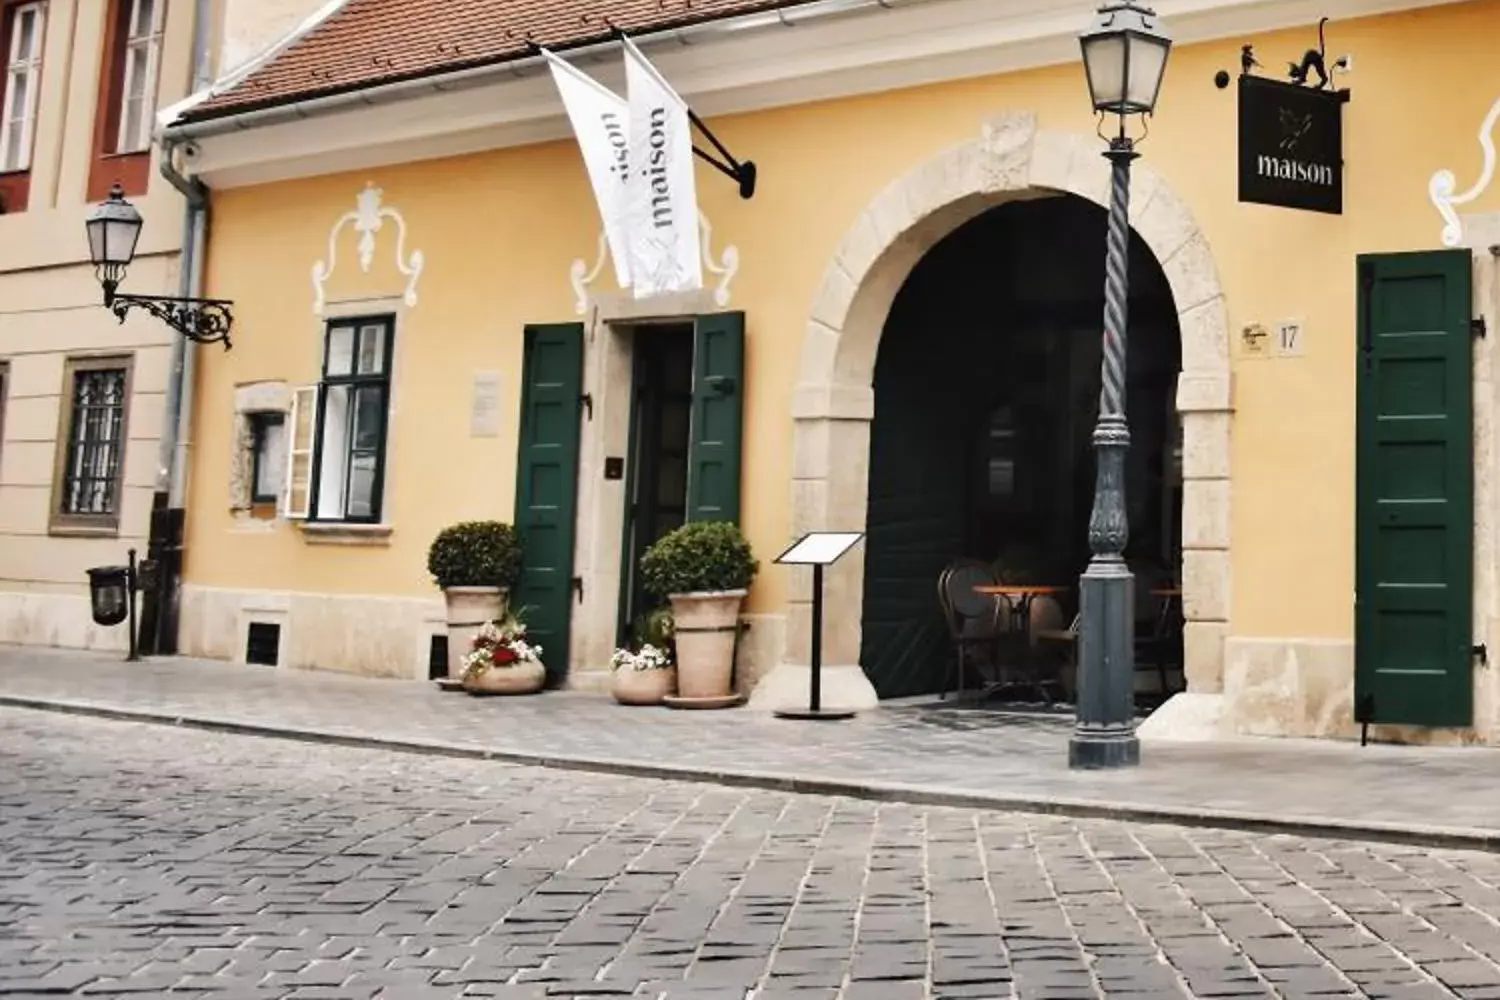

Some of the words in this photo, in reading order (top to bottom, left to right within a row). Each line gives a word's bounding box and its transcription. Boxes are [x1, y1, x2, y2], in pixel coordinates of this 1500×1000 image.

[642, 107, 673, 229] maison
[1257, 154, 1333, 186] maison
[1281, 325, 1298, 349] 17
